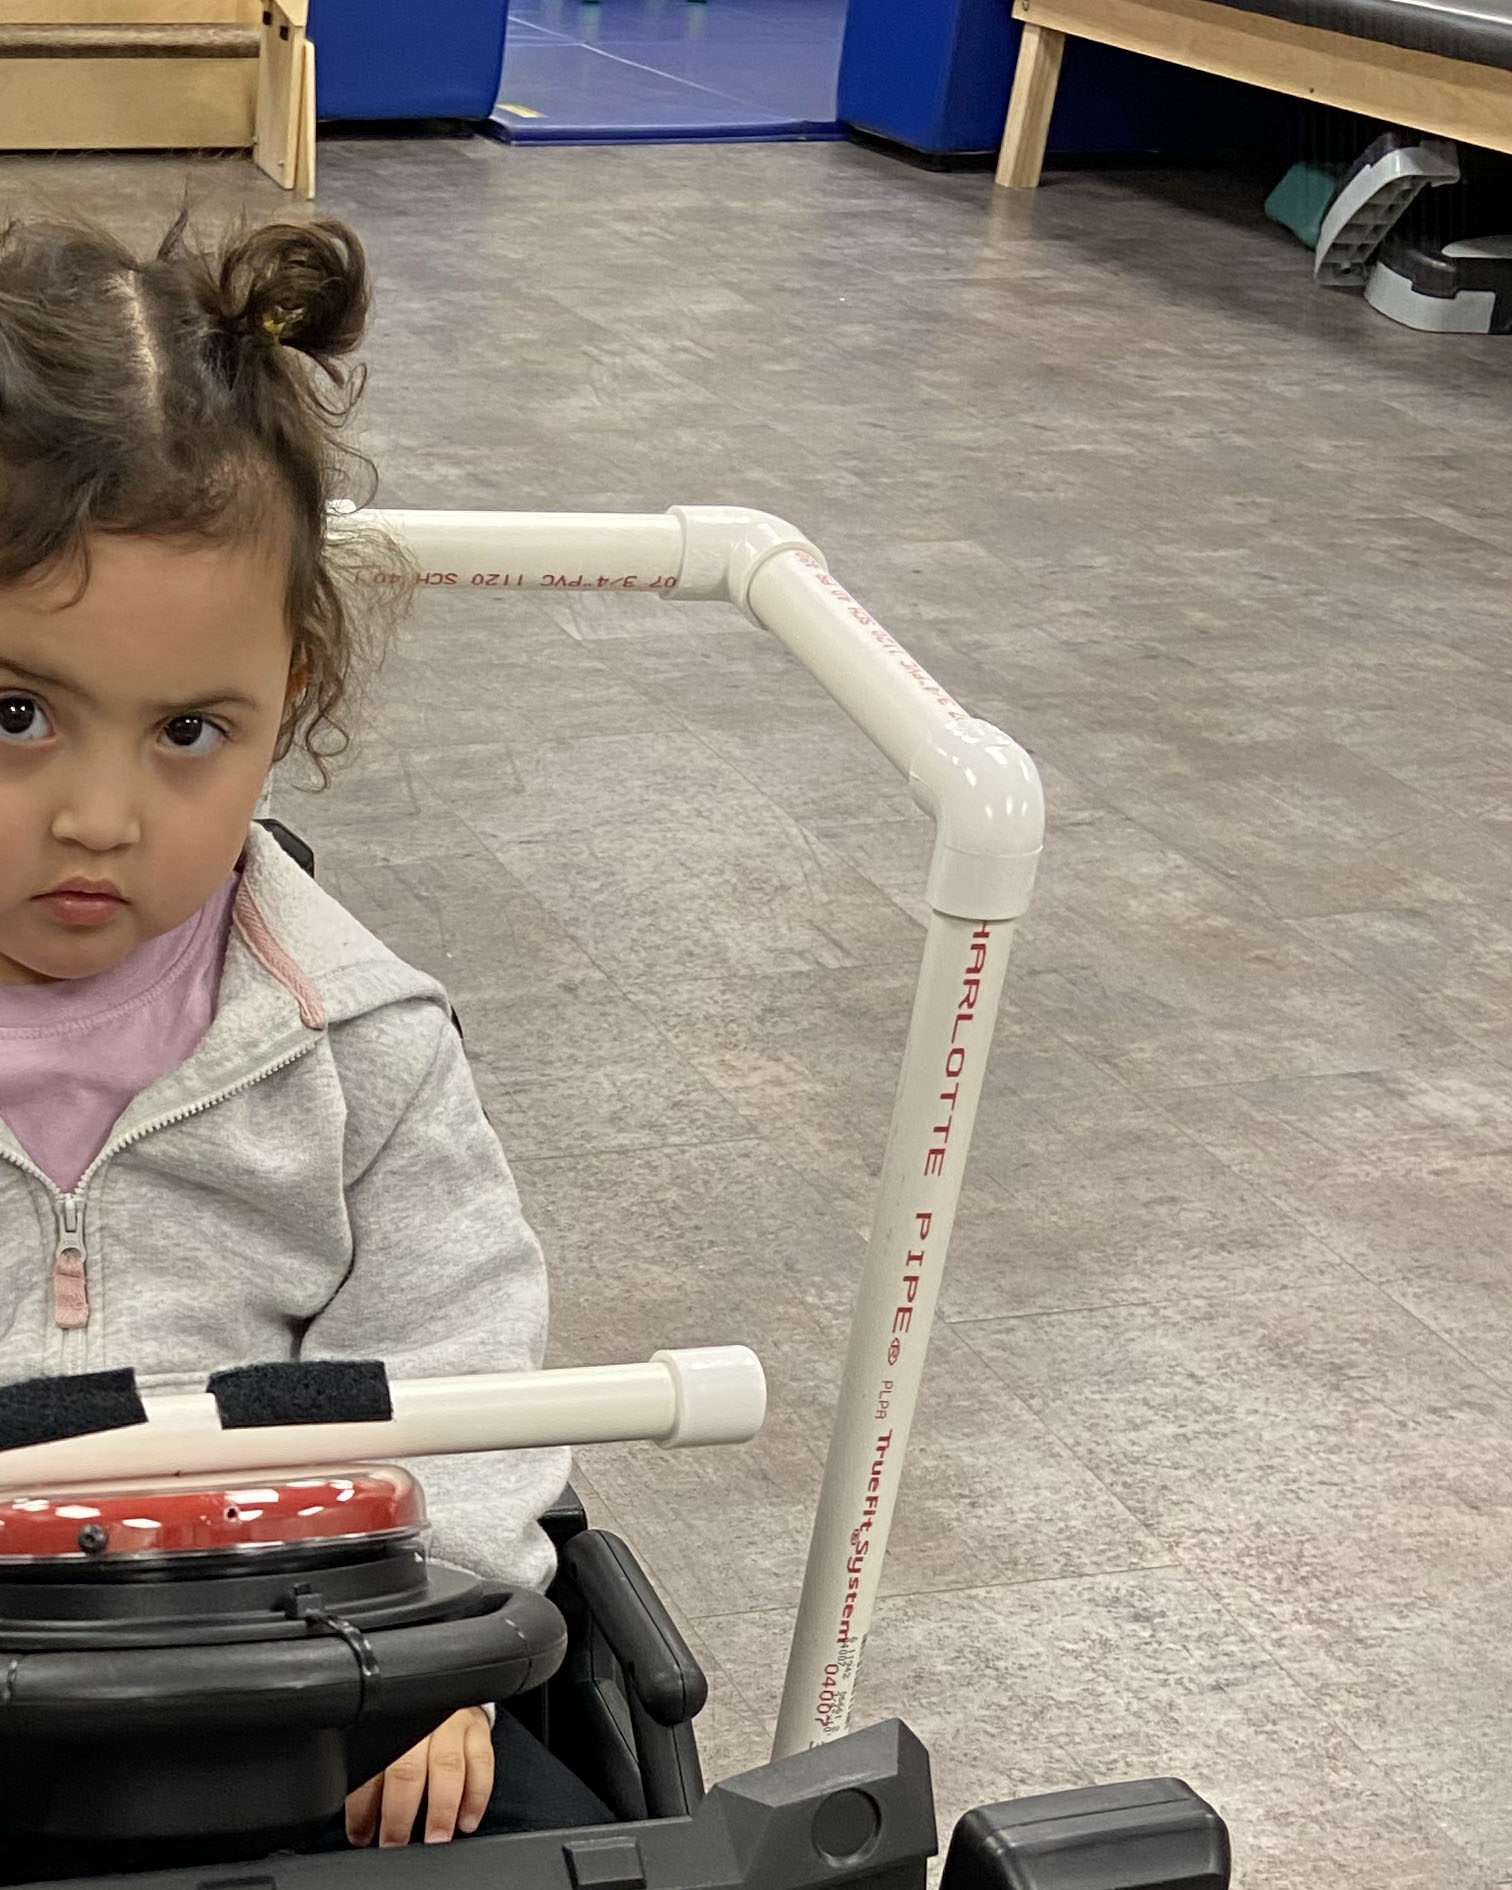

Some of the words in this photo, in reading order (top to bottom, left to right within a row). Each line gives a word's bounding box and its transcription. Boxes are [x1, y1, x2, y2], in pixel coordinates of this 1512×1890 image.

[416, 572, 458, 585] SCH
[471, 573, 525, 587] 1120
[874, 1380, 895, 1420] PLPA
[814, 1663, 839, 1727] 04007
